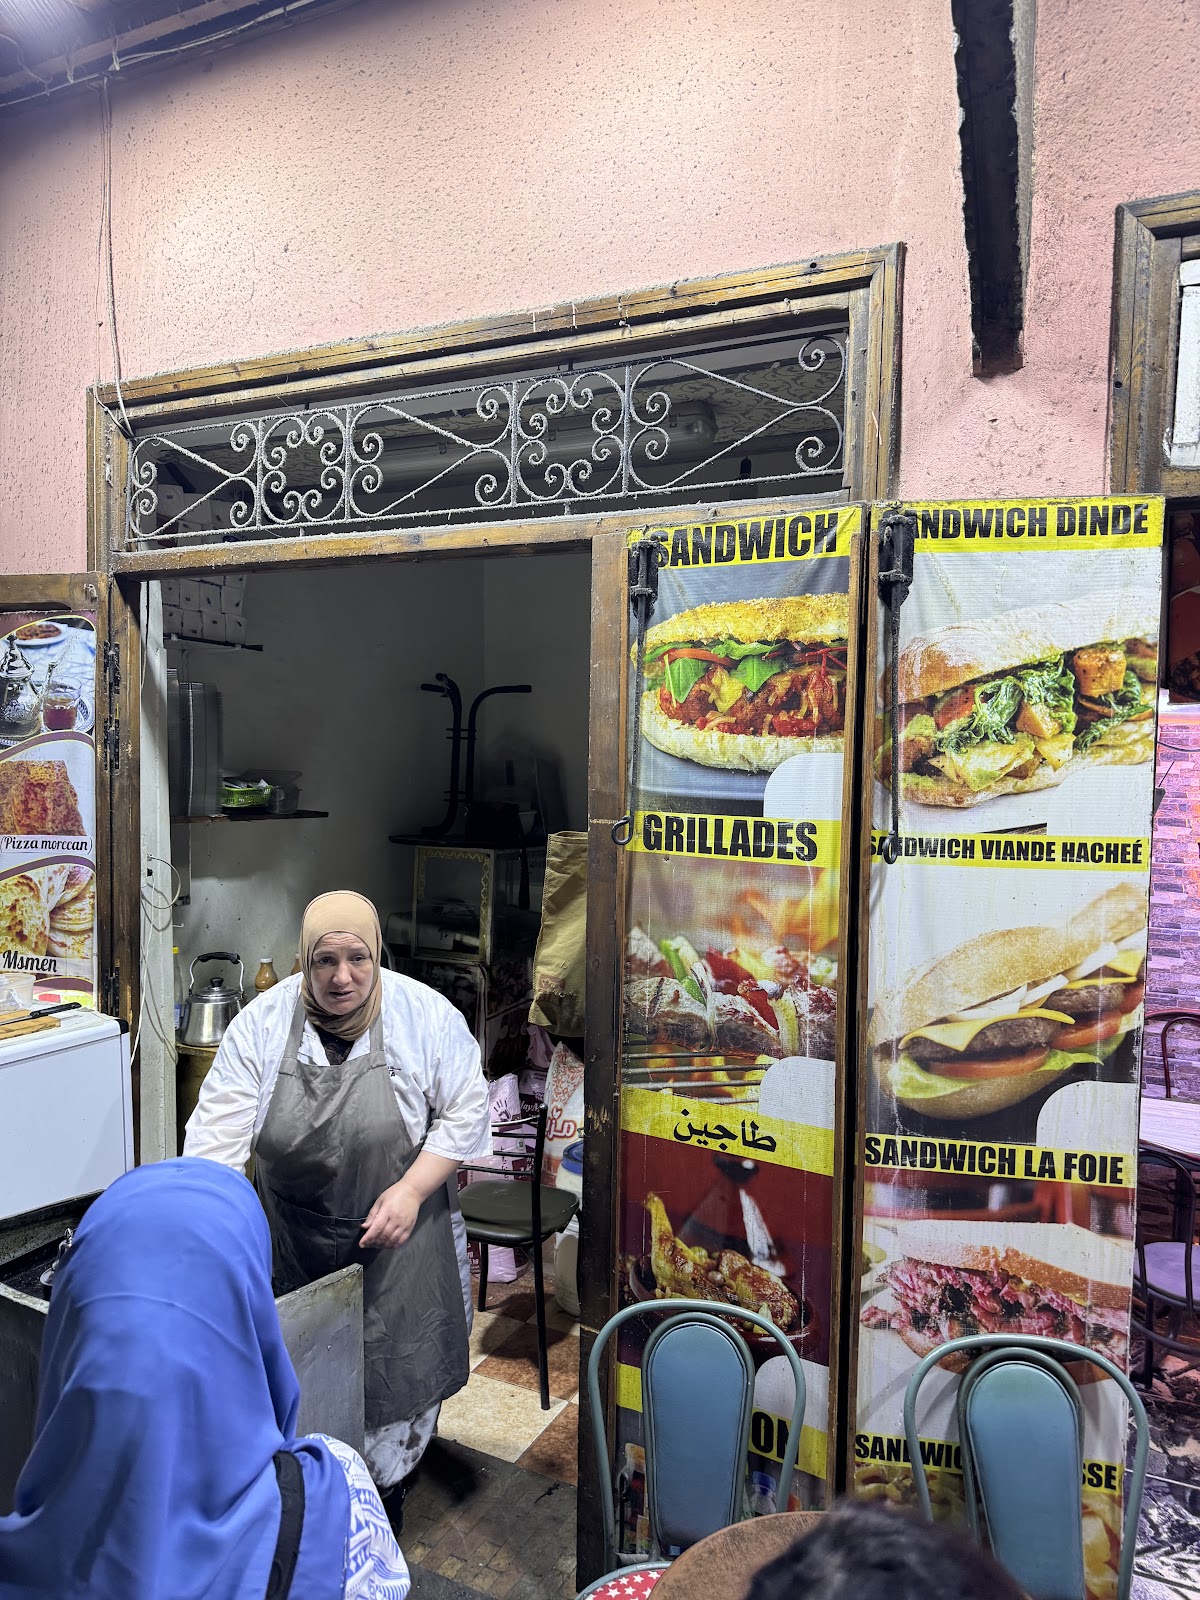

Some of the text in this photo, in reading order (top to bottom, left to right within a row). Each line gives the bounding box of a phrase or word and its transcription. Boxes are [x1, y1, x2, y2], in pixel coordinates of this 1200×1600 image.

[883, 503, 1149, 540] NDWICH DINDE
[643, 814, 818, 862] GRILLADES
[980, 839, 1056, 863] VIANDE
[1061, 839, 1143, 865] HACHEÉ
[2, 949, 58, 973] Msmen
[673, 1108, 777, 1153] طاجين
[865, 1136, 1124, 1185] SANDWICH LA FOIE
